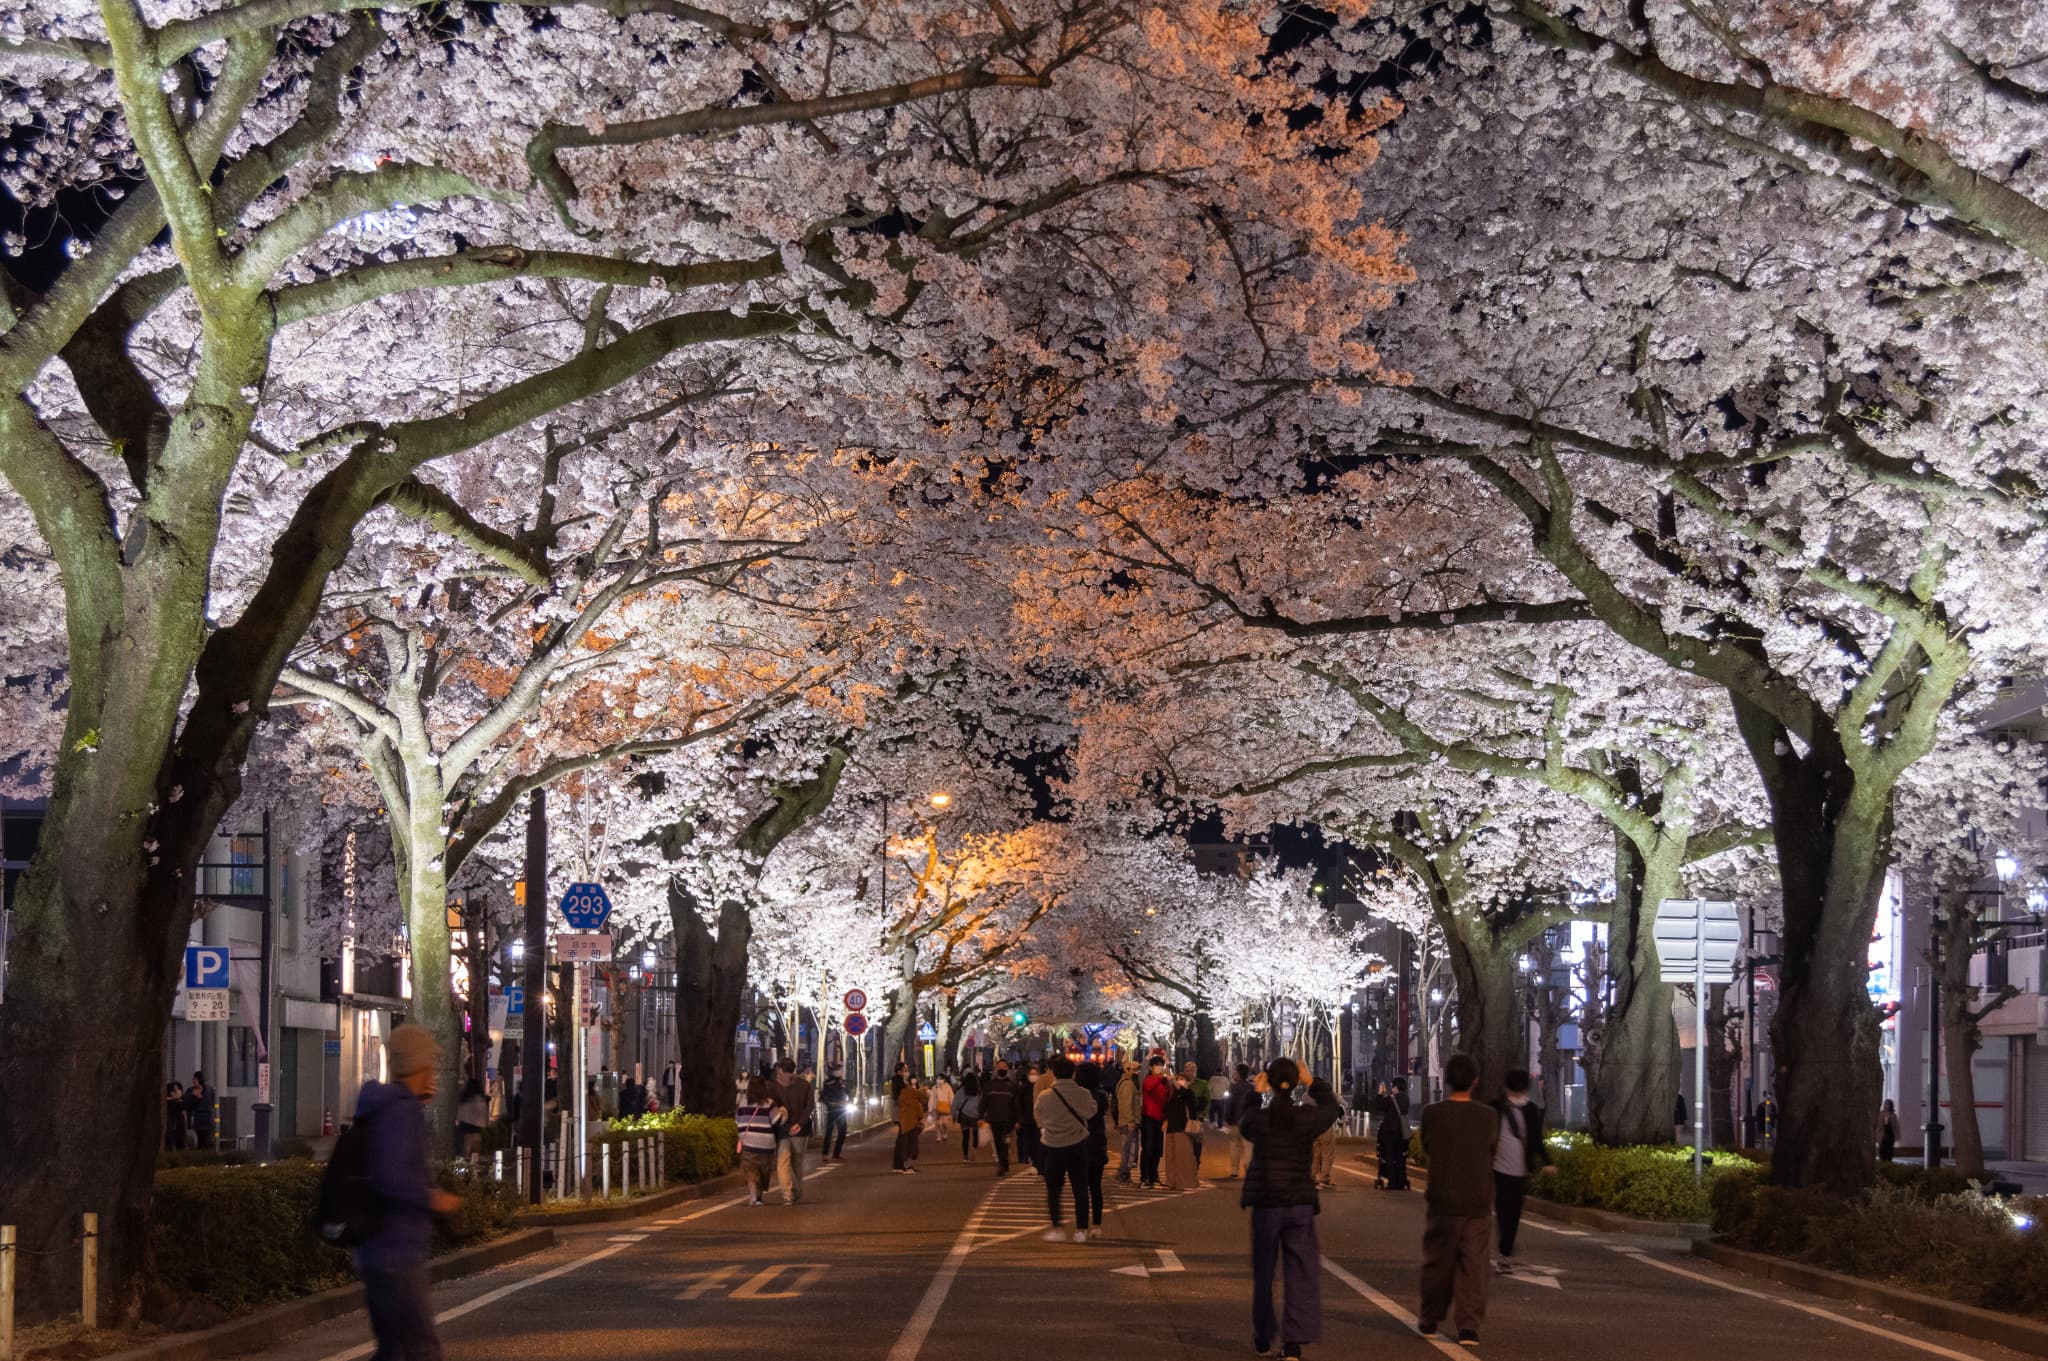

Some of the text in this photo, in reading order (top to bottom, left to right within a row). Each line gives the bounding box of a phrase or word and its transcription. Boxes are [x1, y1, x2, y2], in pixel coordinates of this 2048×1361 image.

[568, 895, 603, 915] 293
[197, 950, 222, 985] P
[212, 1001, 223, 1009] 20
[849, 995, 863, 1006] 40
[190, 1010, 227, 1018] ここまで
